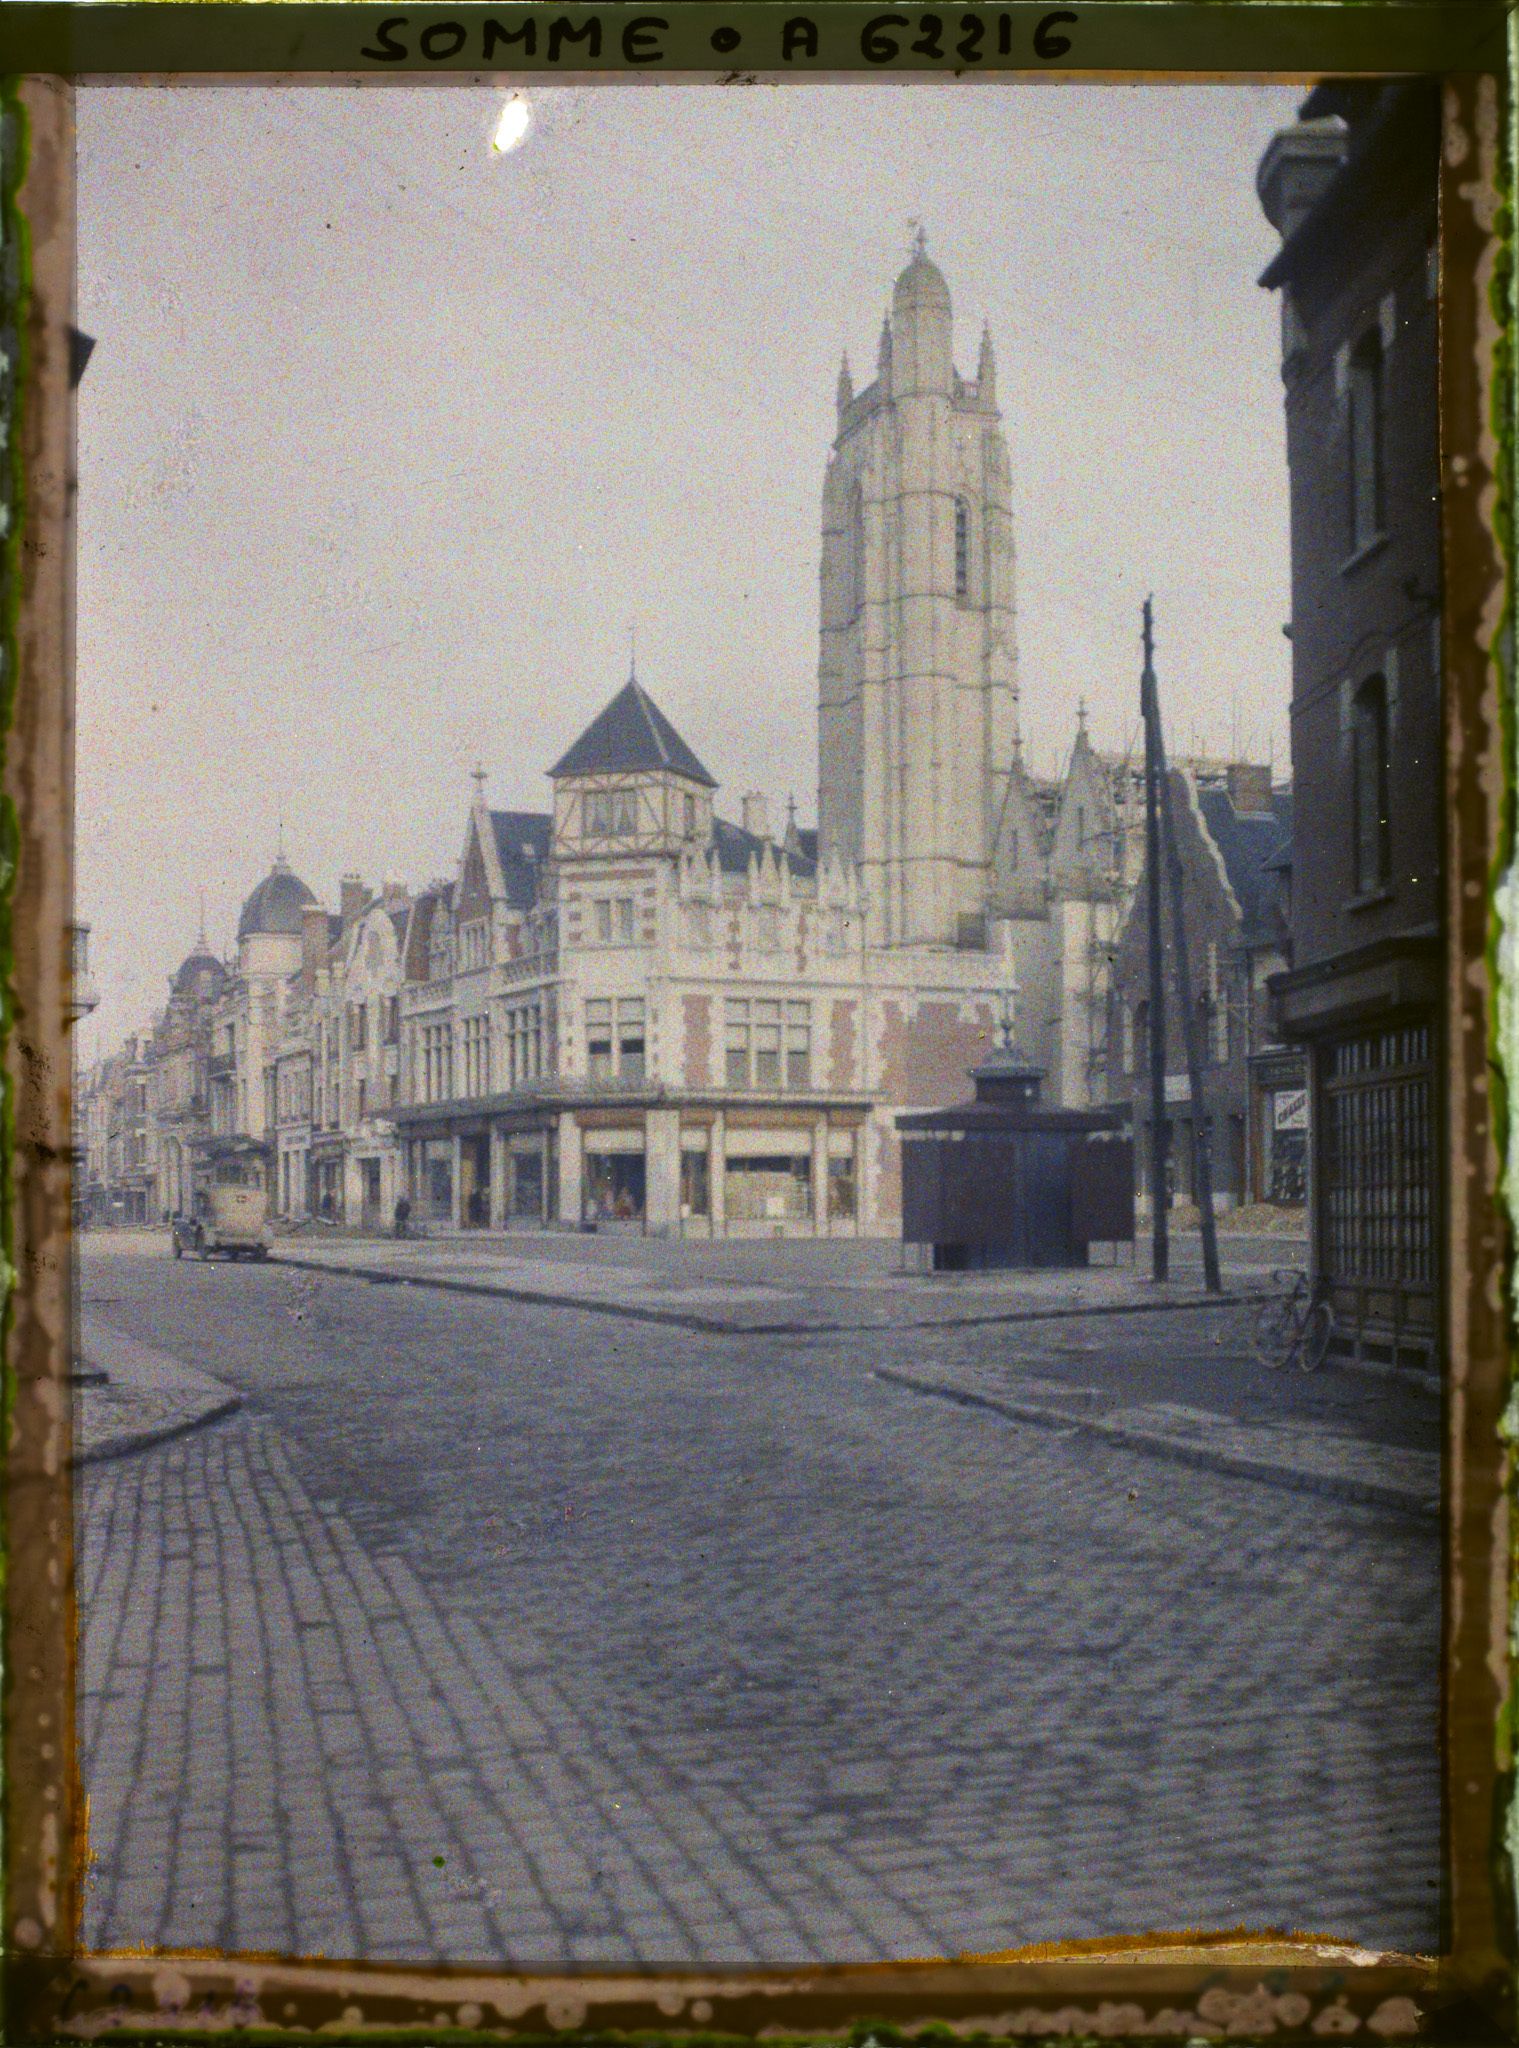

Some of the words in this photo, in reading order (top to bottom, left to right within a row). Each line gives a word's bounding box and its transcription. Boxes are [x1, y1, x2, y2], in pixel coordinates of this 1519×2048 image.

[360, 17, 669, 63] SOMME
[780, 17, 818, 61] A
[860, 11, 1078, 63] 62216
